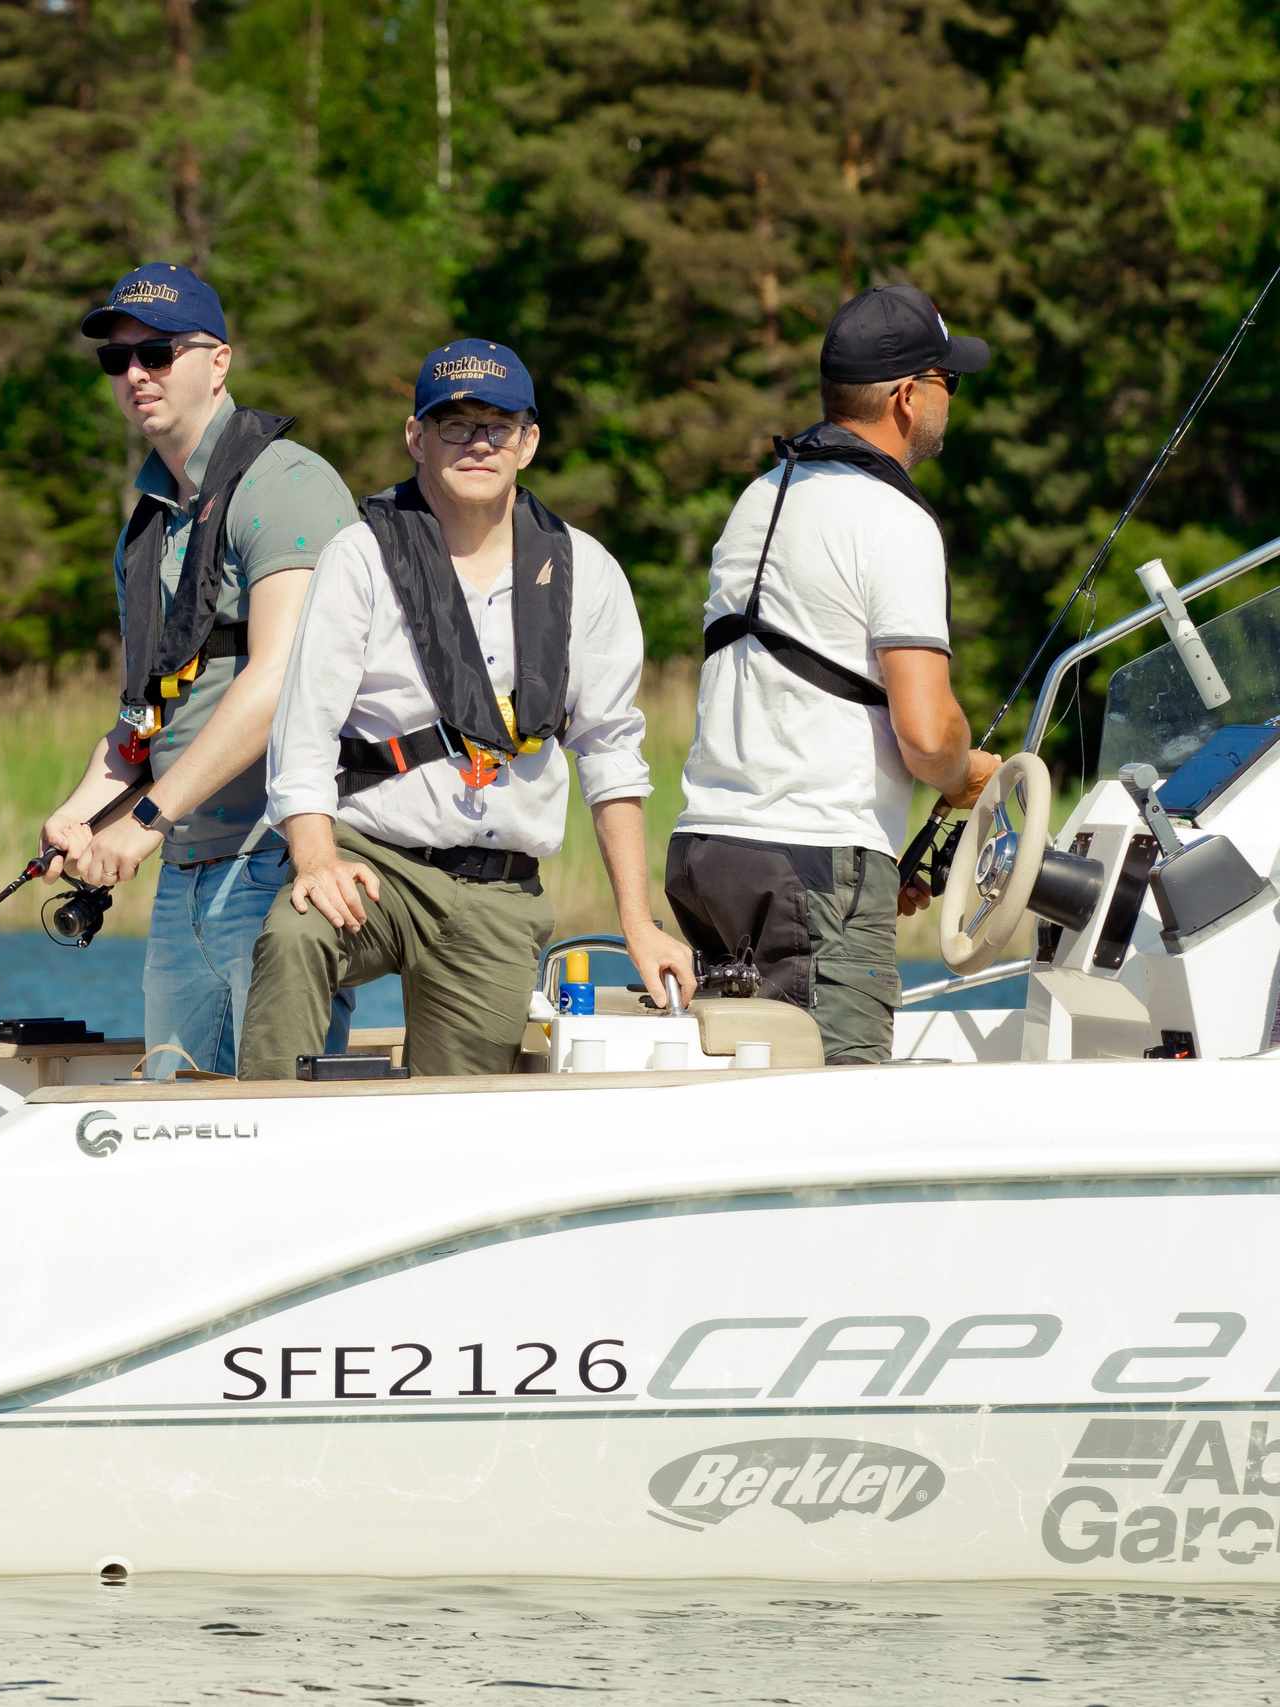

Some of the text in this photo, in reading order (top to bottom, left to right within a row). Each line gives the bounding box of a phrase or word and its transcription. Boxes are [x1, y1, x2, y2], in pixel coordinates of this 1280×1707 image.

[433, 356, 507, 380] Stockholm
[450, 372, 485, 380] SWEDEN
[133, 1122, 258, 1141] CAPELLI
[222, 1339, 628, 1400] SFE2126
[646, 1314, 1063, 1400] CAP
[1041, 1485, 1280, 1564] Garc
